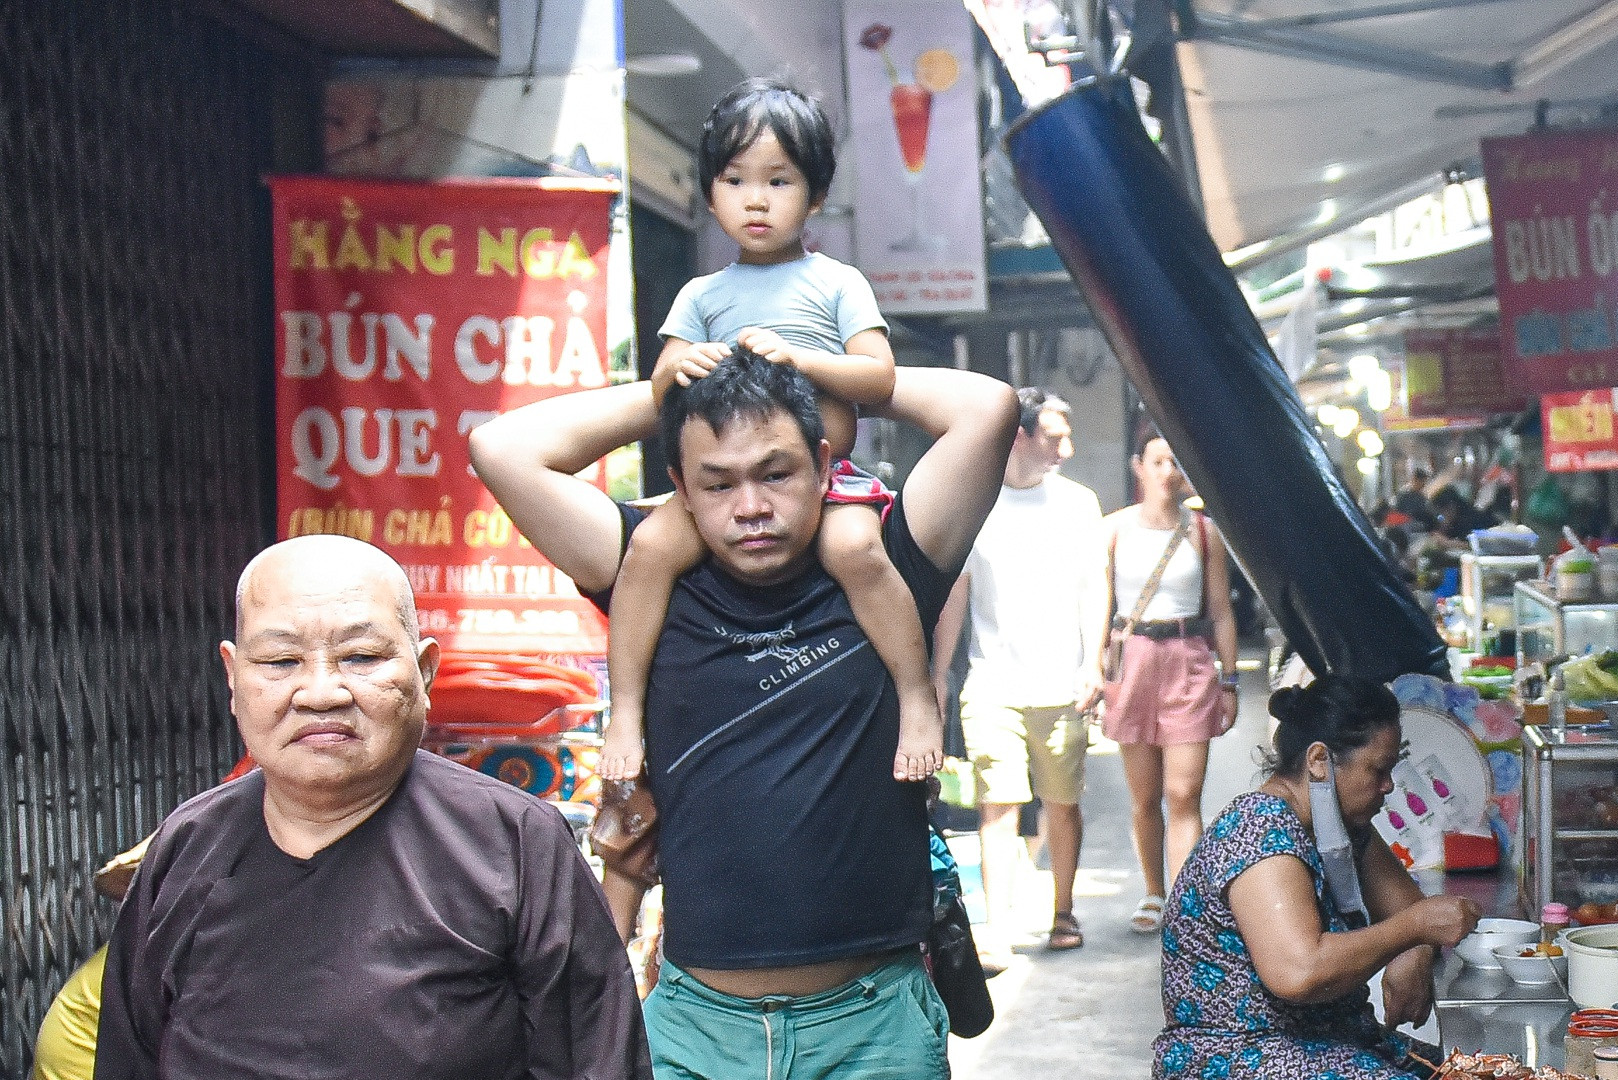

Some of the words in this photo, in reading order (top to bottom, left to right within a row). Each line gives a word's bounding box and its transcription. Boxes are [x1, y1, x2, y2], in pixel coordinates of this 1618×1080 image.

[475, 226, 598, 281] NGA
[1505, 203, 1581, 284] BÚN
[280, 292, 436, 384] BÚN
[453, 290, 607, 389] CHẢ
[291, 405, 442, 490] QUE
[403, 564, 440, 594] UY
[758, 636, 841, 692] CLIMBING
